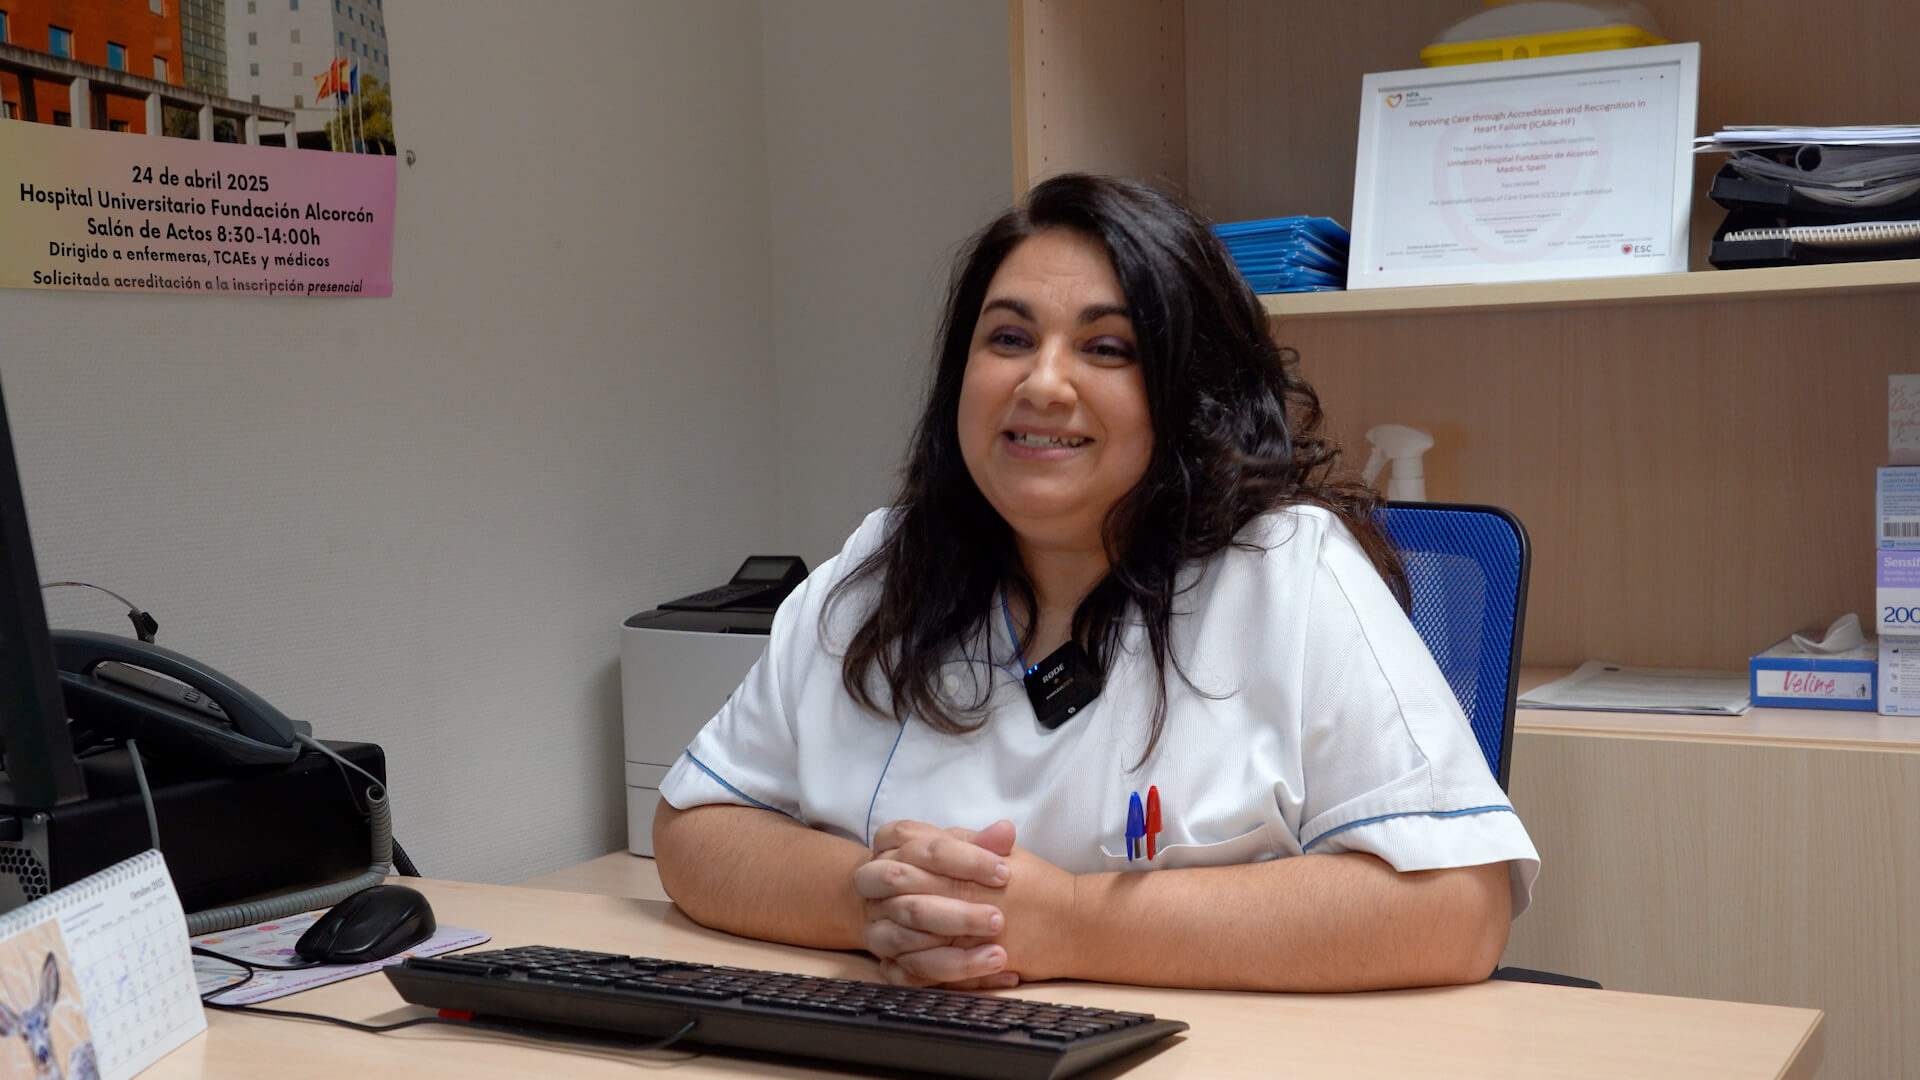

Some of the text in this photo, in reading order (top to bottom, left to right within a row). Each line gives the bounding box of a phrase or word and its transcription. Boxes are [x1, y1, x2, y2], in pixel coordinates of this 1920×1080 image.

[1408, 98, 1646, 128] Improving Care through Accreditation and Recognition in
[1473, 123, 1497, 134] Heart
[1499, 121, 1528, 132] Failure
[1447, 149, 1599, 168] University Hospital Fundación de Alcorcón
[1496, 163, 1546, 174] Madrid, Spain
[131, 165, 269, 192] 24 de abril 2025
[20, 183, 373, 223] Hospital Universitario Fundación Alcorcón
[87, 217, 320, 246] Salón de Actos 8:30-14:00h
[50, 241, 330, 270] Dirigido a enfermeras, TCAEs y médicos
[1634, 244, 1653, 254] ESC
[33, 269, 363, 296] Solicitada acreditación a la inscripción presencial
[1783, 670, 1835, 694] Veline
